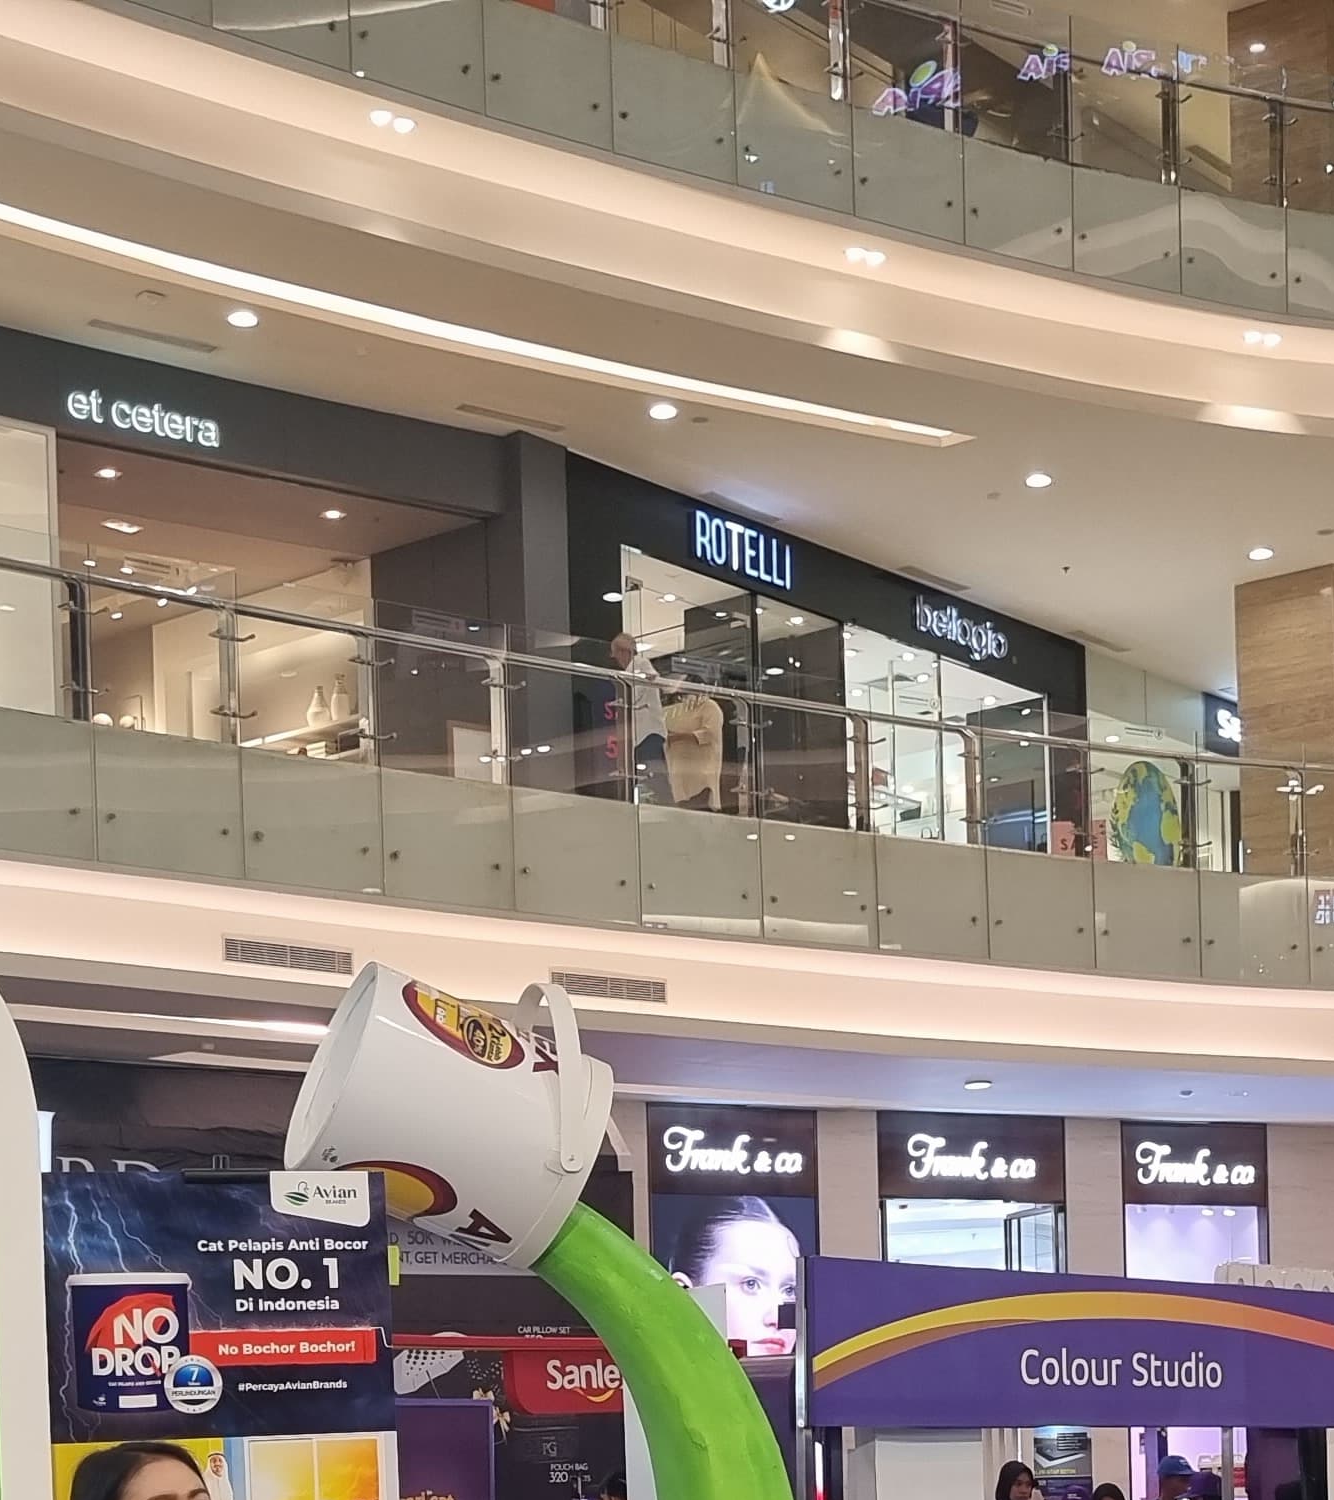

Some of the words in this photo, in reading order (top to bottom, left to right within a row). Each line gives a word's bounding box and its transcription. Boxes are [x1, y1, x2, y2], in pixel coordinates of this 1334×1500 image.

[66, 387, 104, 426] et
[110, 398, 222, 449] cetera
[695, 509, 791, 590] ROTELLI
[916, 595, 1008, 661] bellagio
[663, 1125, 751, 1174] Frank
[754, 1150, 772, 1173] &
[907, 1133, 988, 1181] Frank
[989, 1156, 1008, 1179] &
[1135, 1141, 1211, 1187] Frank
[1212, 1164, 1229, 1185] &
[313, 1185, 357, 1200] Avian
[197, 1240, 224, 1252] Cat
[228, 1238, 284, 1254] Pelapis
[288, 1238, 320, 1251] Anti
[324, 1239, 369, 1251] Bocor
[414, 1251, 438, 1264] GET
[233, 1257, 312, 1290] NO.
[322, 1257, 340, 1289] 1
[235, 1298, 254, 1312] Di
[258, 1296, 340, 1312] Indonesia
[113, 1307, 180, 1345] NO
[517, 1326, 532, 1334] CAR
[559, 1326, 571, 1334] SET
[91, 1345, 181, 1377] DROP
[218, 1344, 239, 1355] No
[242, 1342, 296, 1355] Bochor
[299, 1340, 356, 1353] Bochor!
[188, 1367, 200, 1381] 7
[547, 1359, 621, 1390] Sanle
[1020, 1348, 1122, 1387] Colour
[1131, 1350, 1224, 1390] Studio
[238, 1379, 348, 1393] #PercayaAvianBrands
[549, 1472, 568, 1483] 320
